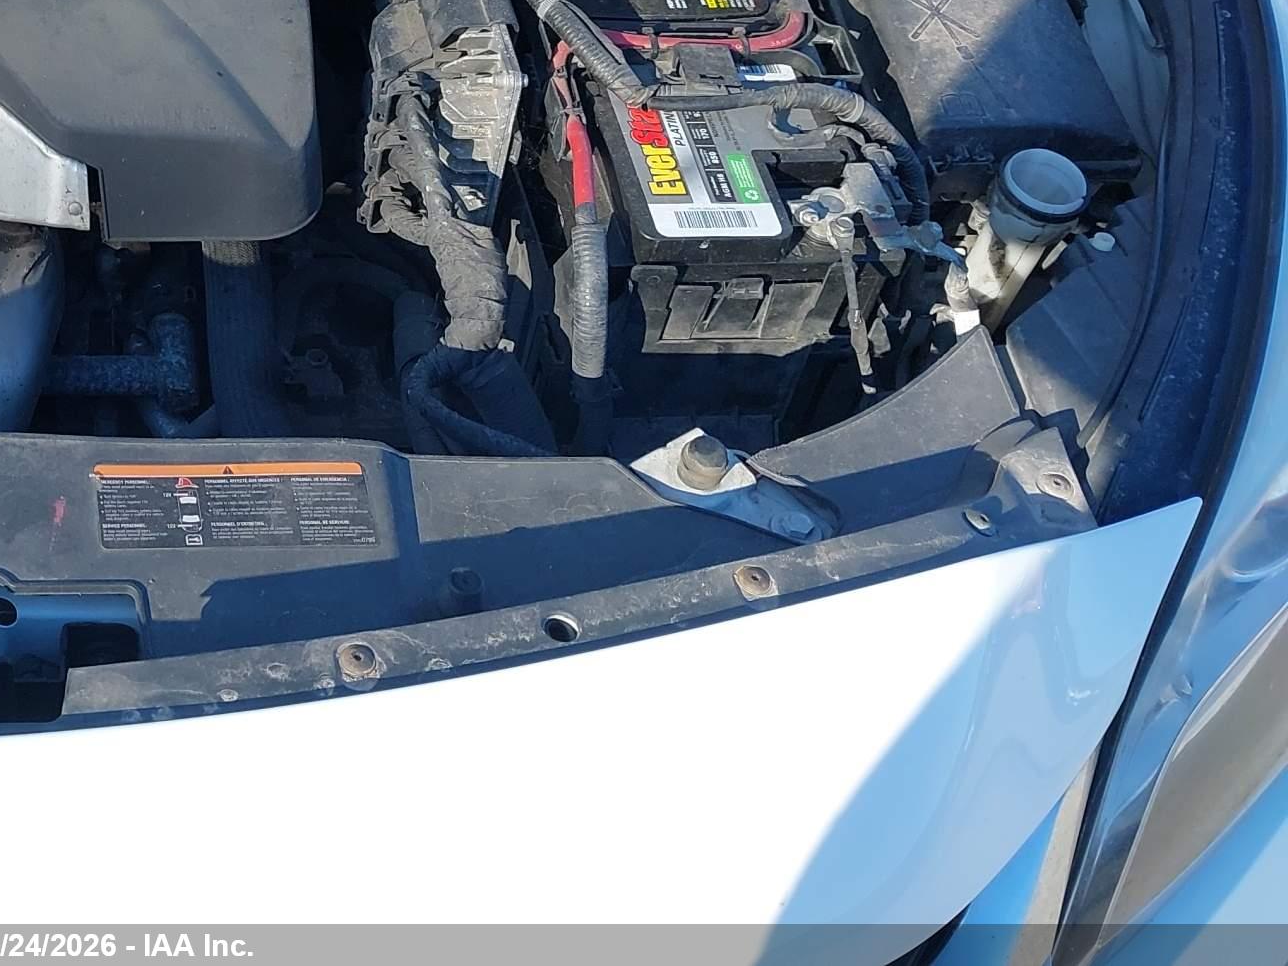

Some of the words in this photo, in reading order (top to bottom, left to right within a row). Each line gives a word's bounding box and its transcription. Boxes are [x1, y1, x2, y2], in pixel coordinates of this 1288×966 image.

[664, 111, 688, 147] PLATIN
[697, 128, 708, 140] 170
[626, 103, 689, 197] EverSta
[710, 151, 720, 165] 850
